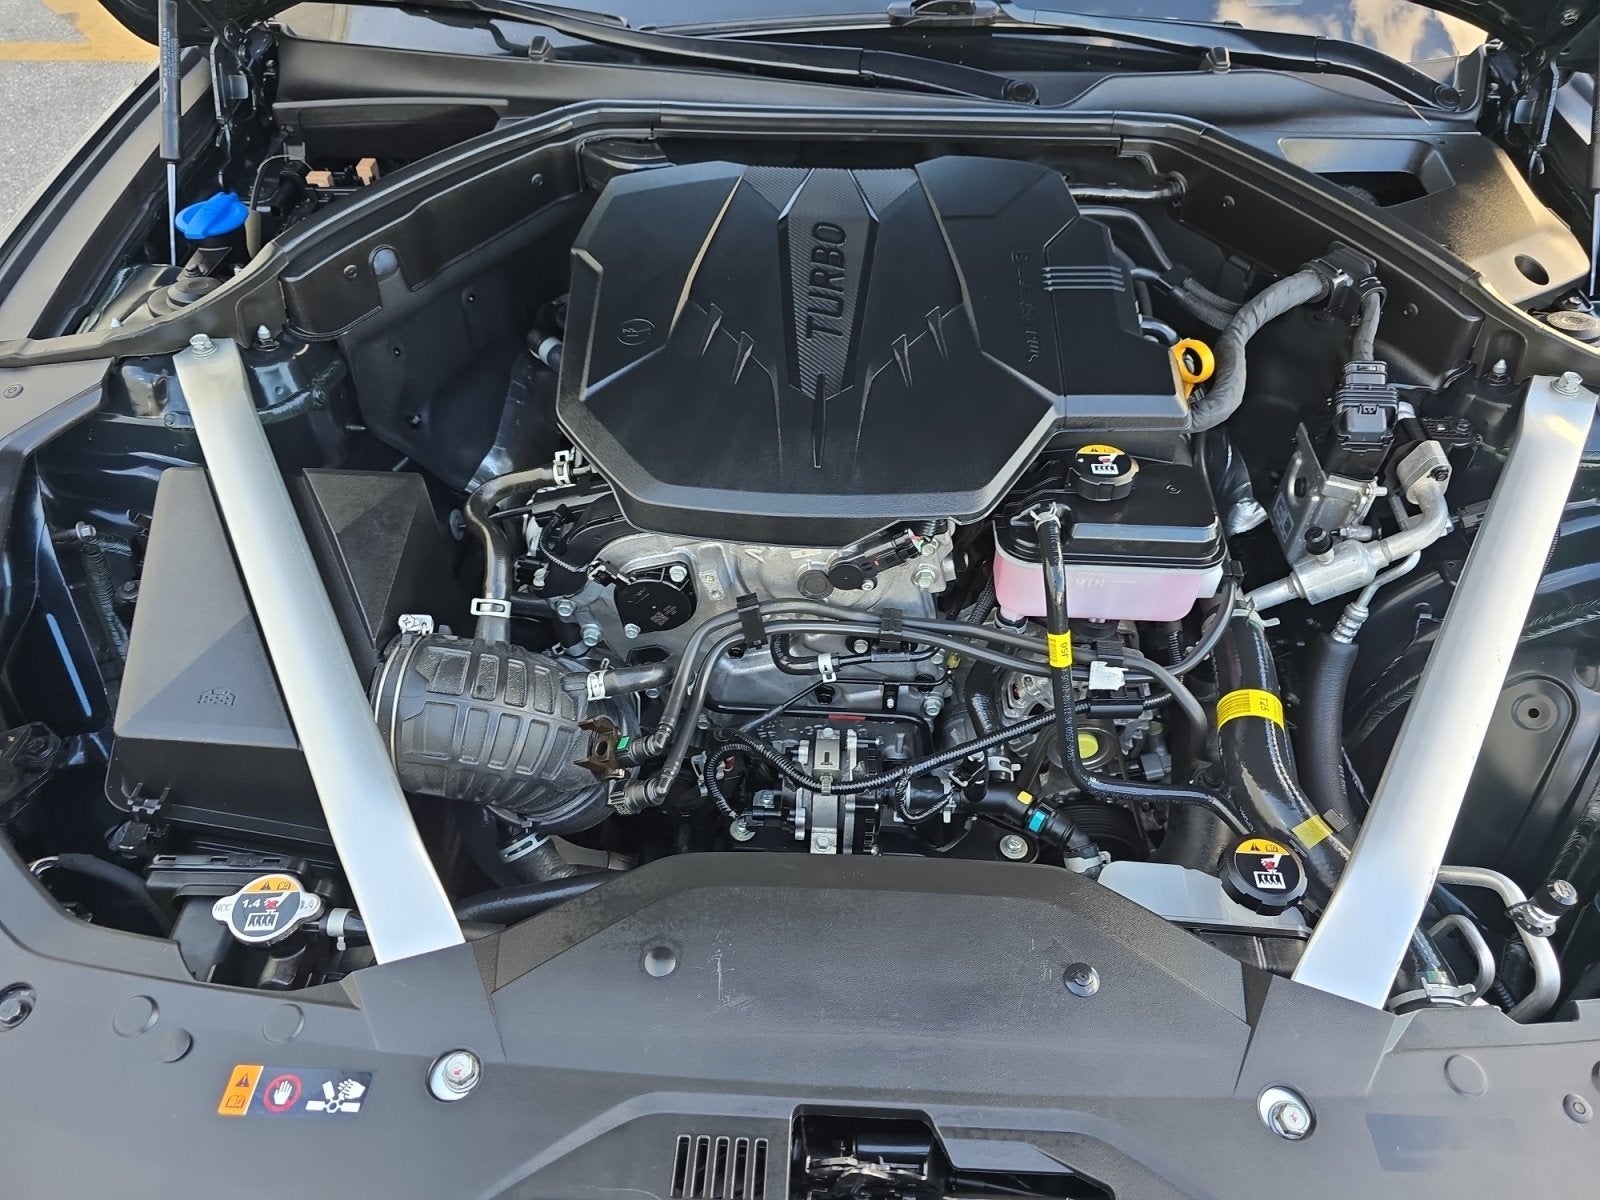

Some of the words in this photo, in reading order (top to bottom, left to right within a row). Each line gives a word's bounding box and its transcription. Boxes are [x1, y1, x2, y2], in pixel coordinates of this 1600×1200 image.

[806, 221, 847, 341] TURBO
[1259, 697, 1270, 712] T25
[242, 898, 262, 909] 1.4
